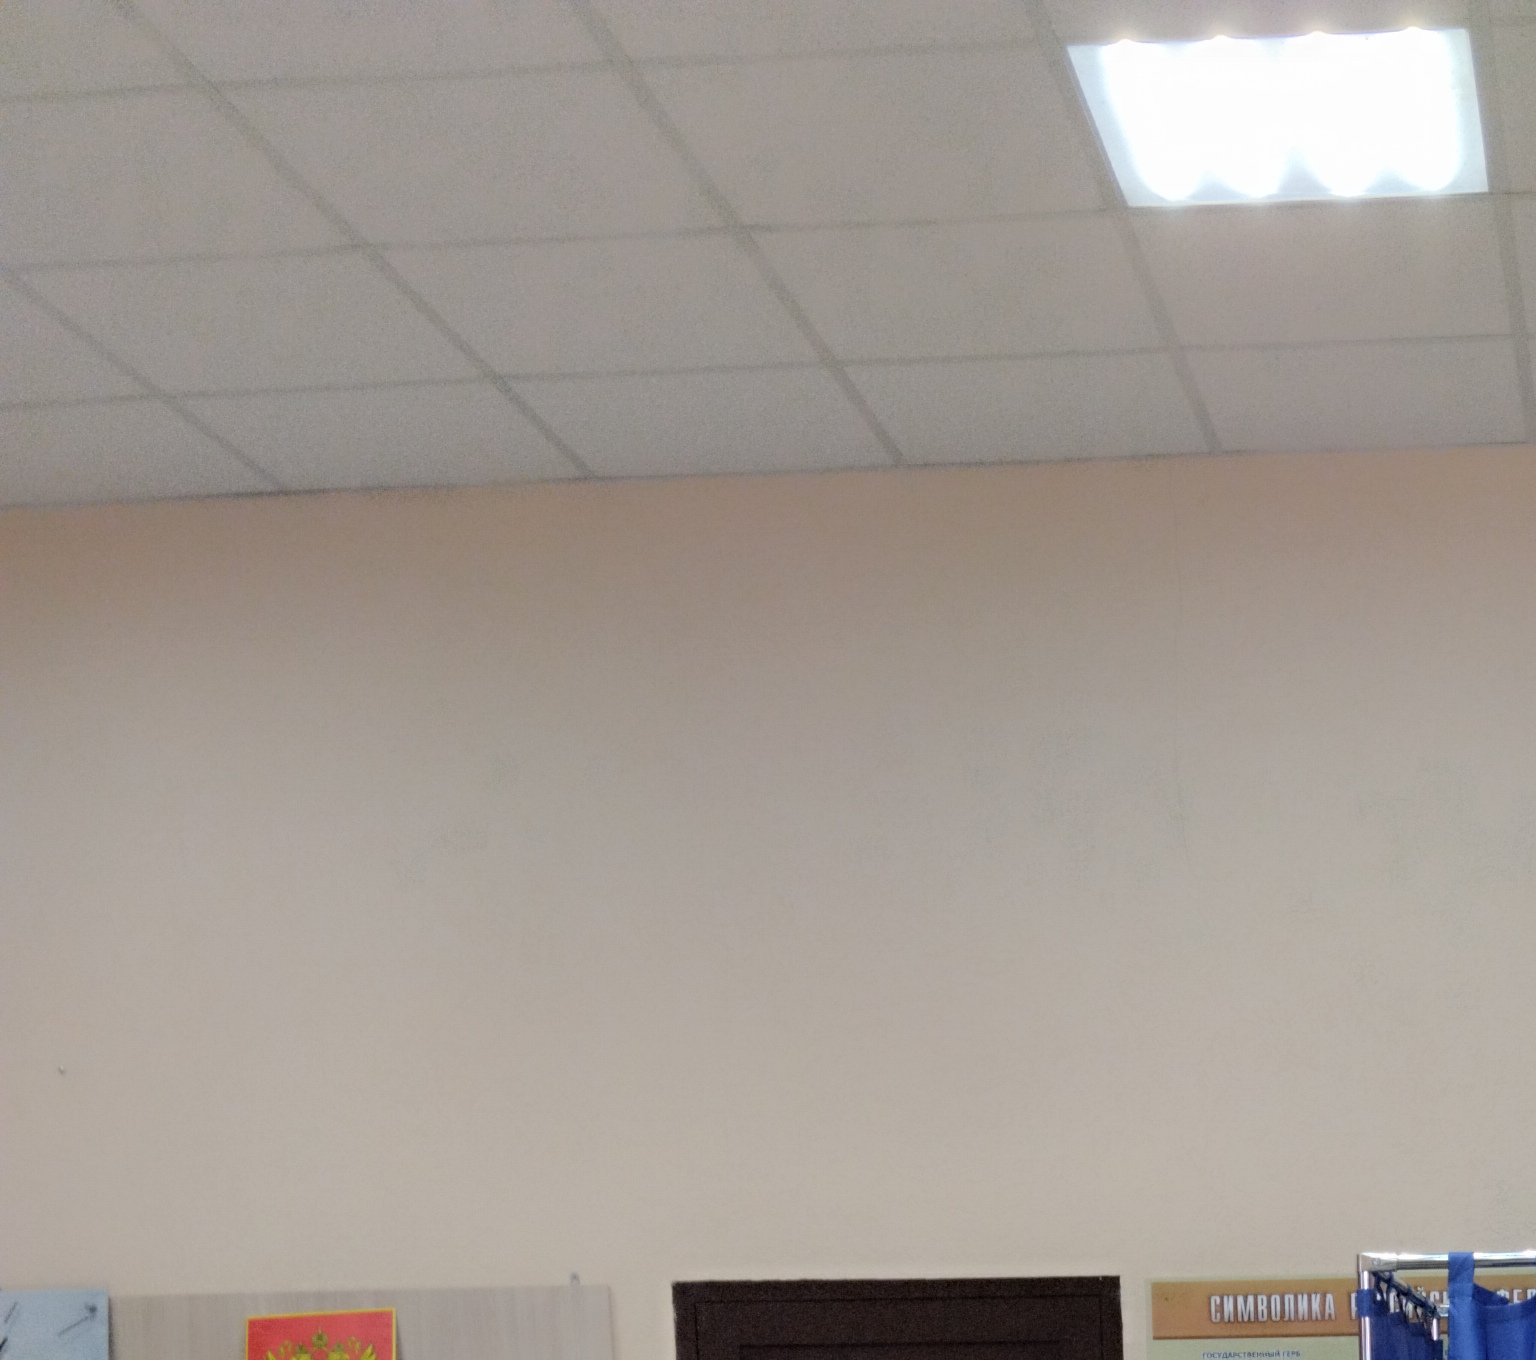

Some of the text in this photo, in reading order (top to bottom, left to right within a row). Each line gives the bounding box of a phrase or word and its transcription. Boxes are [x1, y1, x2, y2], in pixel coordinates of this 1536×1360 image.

[1210, 1292, 1336, 1323] СИМВОЛИКА
[1202, 1349, 1301, 1359] ГОСУДАРСТВЕННЫЙ ГЕРБ
